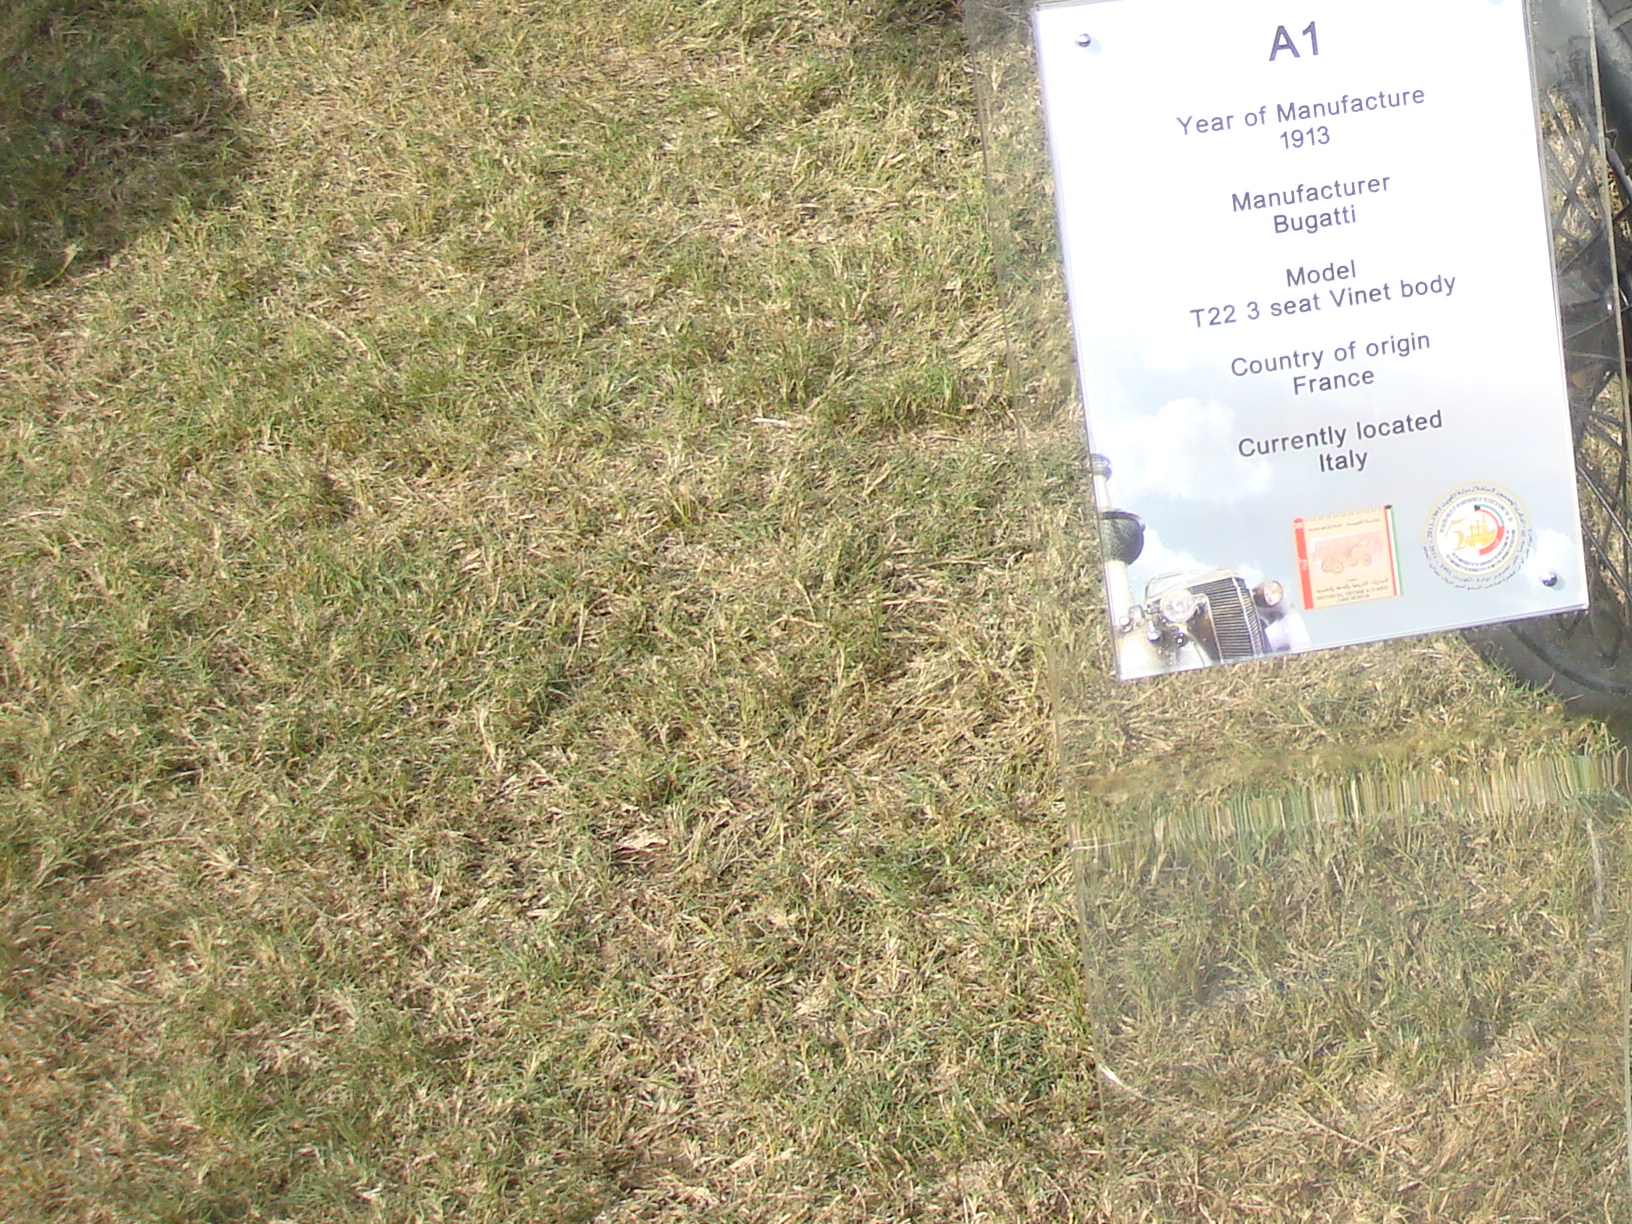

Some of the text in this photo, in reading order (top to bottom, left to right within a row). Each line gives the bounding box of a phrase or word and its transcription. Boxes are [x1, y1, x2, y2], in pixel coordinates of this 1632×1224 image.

[1268, 20, 1320, 62] A1
[1175, 89, 1426, 136] Year of Manufacture
[1279, 125, 1331, 150] 1913
[1231, 176, 1391, 213] Manufacturer
[1273, 203, 1357, 235] Bugatti
[1285, 259, 1357, 288] Model
[1189, 274, 1457, 328] T22 3 seat Vinet body
[1230, 331, 1431, 377] Country of origin
[1292, 370, 1375, 396] France
[1238, 409, 1444, 458] Currently located
[1318, 449, 1368, 473] Italy
